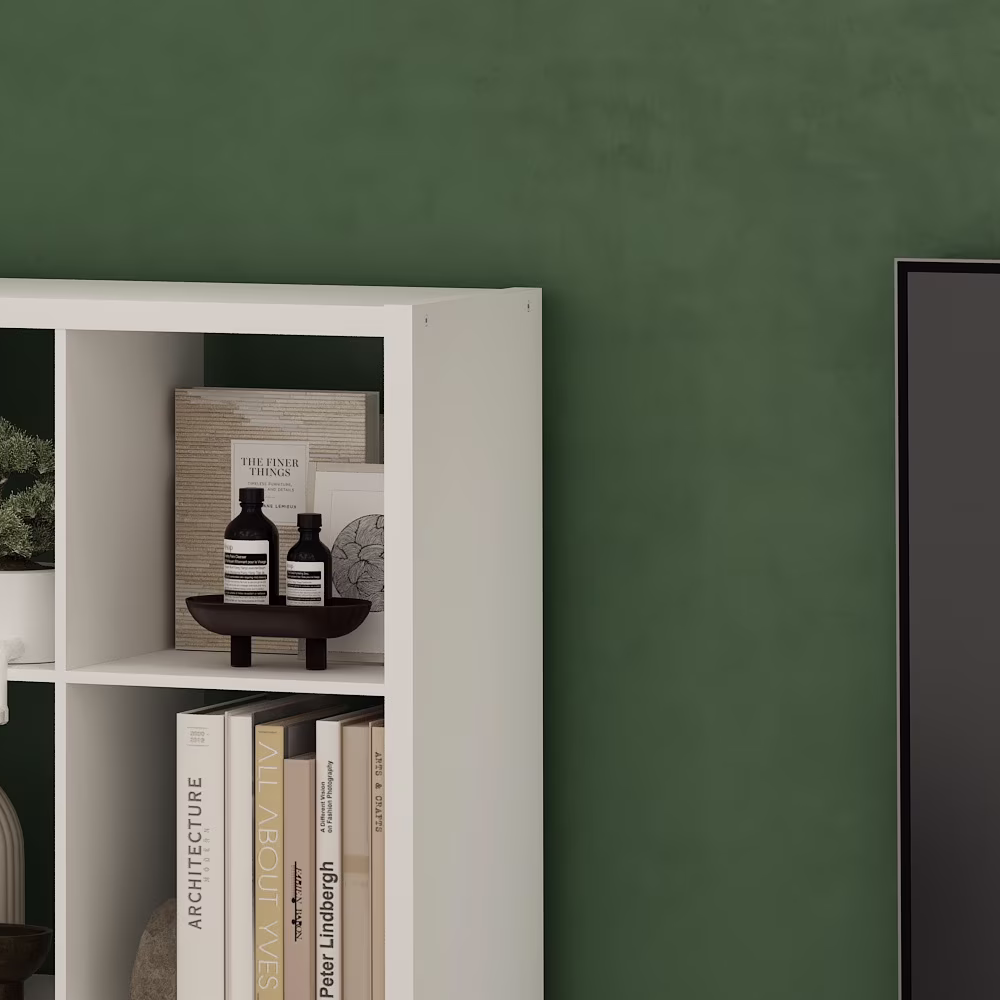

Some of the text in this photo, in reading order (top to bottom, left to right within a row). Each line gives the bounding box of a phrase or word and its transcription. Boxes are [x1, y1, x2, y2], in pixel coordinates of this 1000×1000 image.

[240, 457, 299, 467] THE FINER
[249, 467, 291, 477] THINGS
[258, 741, 278, 793] ALL
[326, 760, 334, 799] Photography
[375, 751, 383, 776] ARTS
[375, 795, 383, 833] CRAFTS
[187, 776, 203, 930] ARCHITECTURE
[258, 804, 279, 907] ABOUT
[319, 861, 338, 999] Peter Lindbergh
[258, 920, 279, 991] YVES
